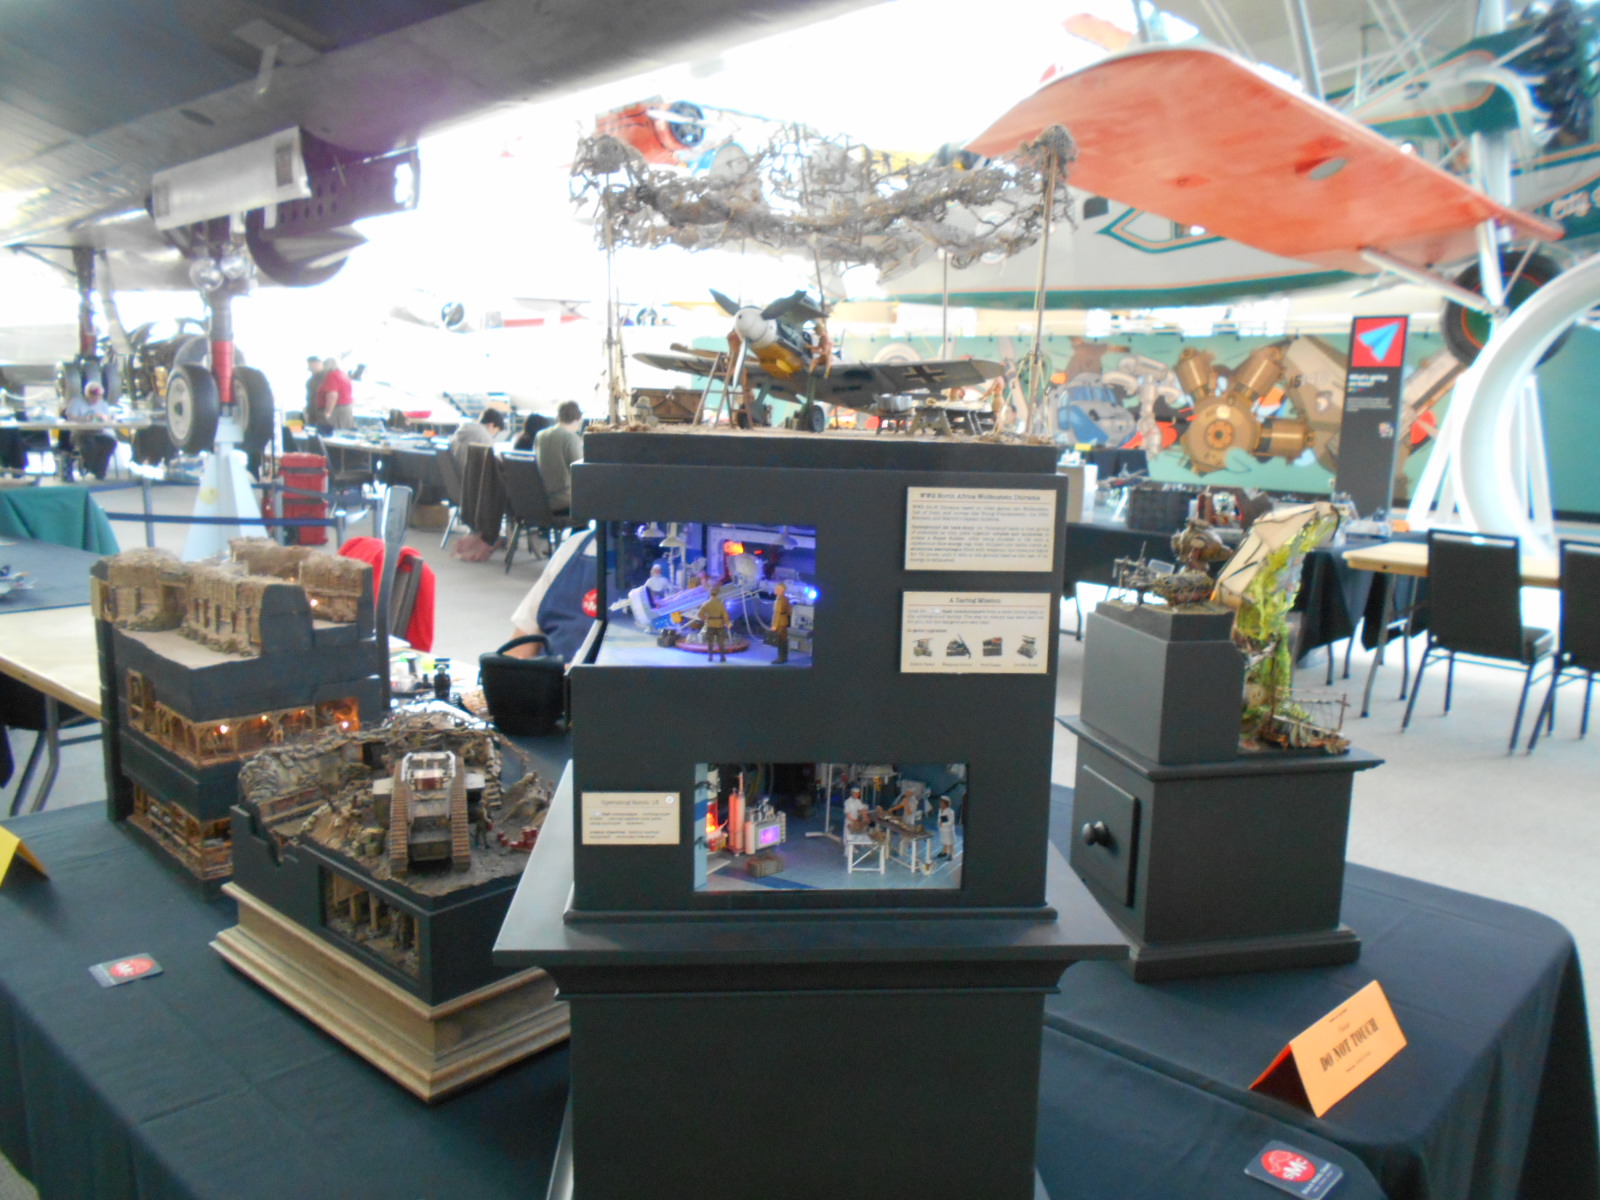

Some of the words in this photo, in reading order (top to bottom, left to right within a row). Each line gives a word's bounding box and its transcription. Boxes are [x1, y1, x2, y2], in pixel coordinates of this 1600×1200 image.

[1319, 1052, 1334, 1072] DO
[1332, 1039, 1353, 1062] NOT
[1350, 1018, 1379, 1047] TOUCH
